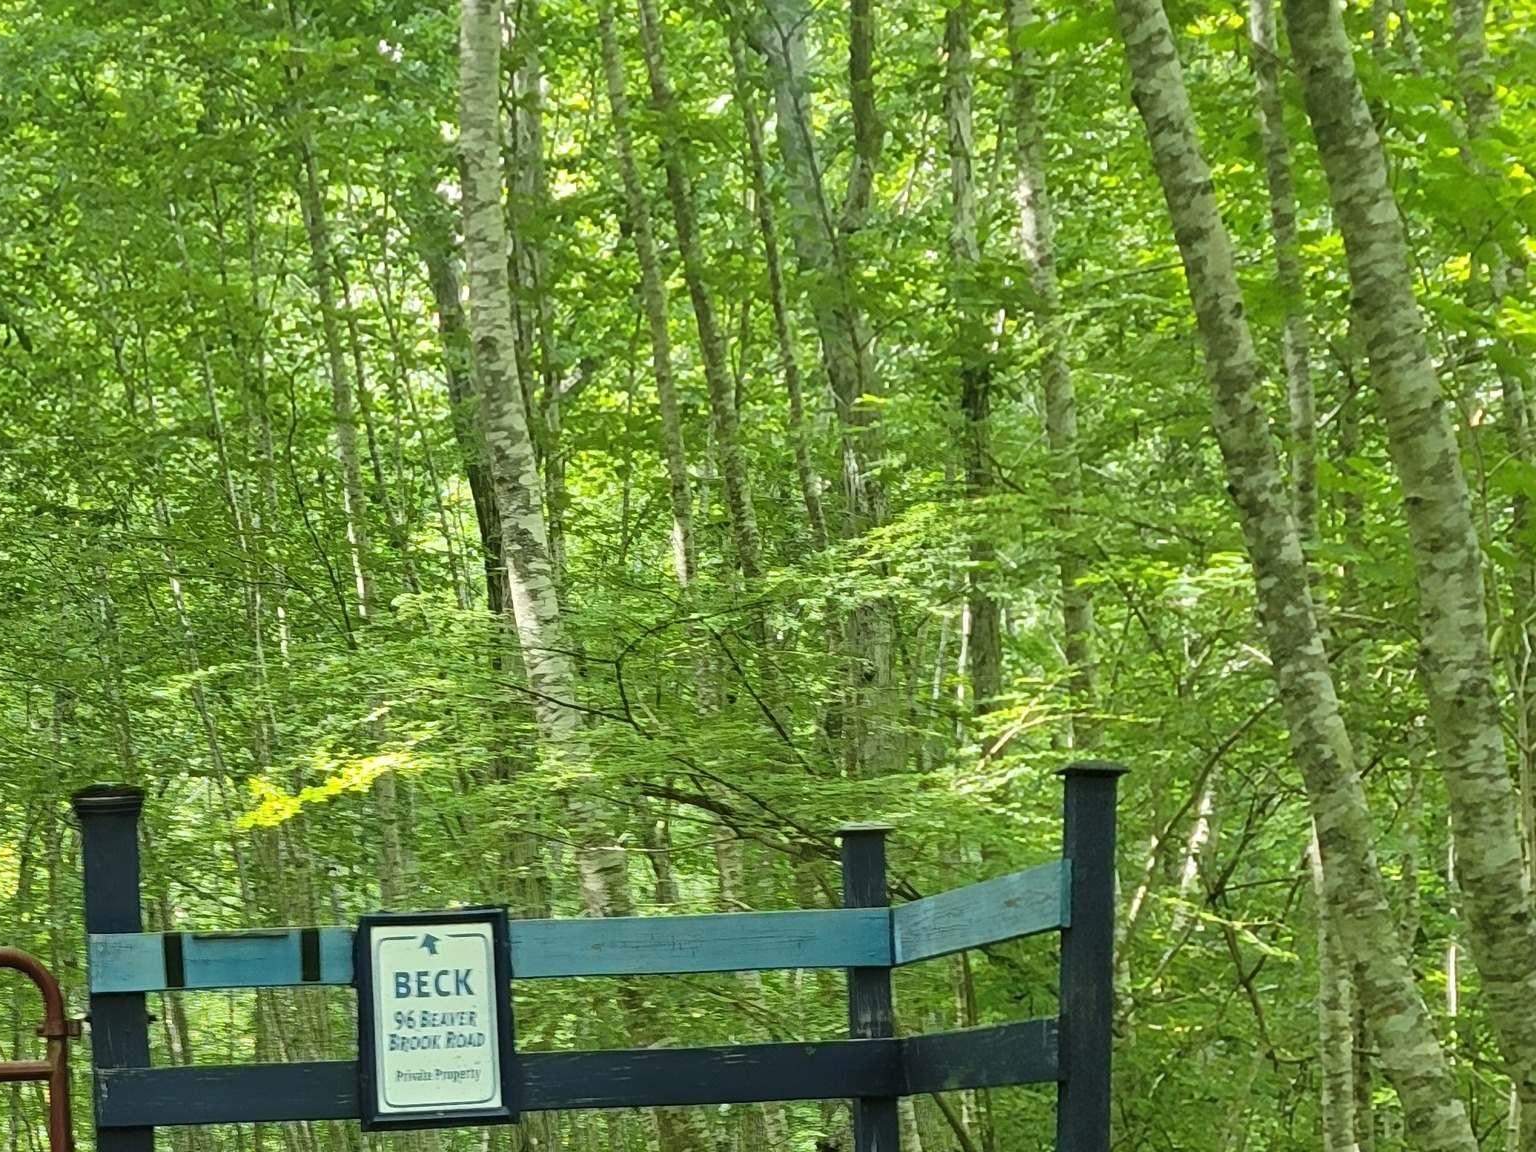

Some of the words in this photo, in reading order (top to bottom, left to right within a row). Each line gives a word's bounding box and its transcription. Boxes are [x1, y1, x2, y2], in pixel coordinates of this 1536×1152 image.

[394, 969, 474, 998] BECK
[394, 1010, 416, 1029] 96
[420, 1010, 477, 1028] BEAVER
[388, 1033, 441, 1052] BROOK
[446, 1031, 485, 1049] ROAD
[396, 1070, 433, 1081] Private
[435, 1068, 481, 1082] Property
